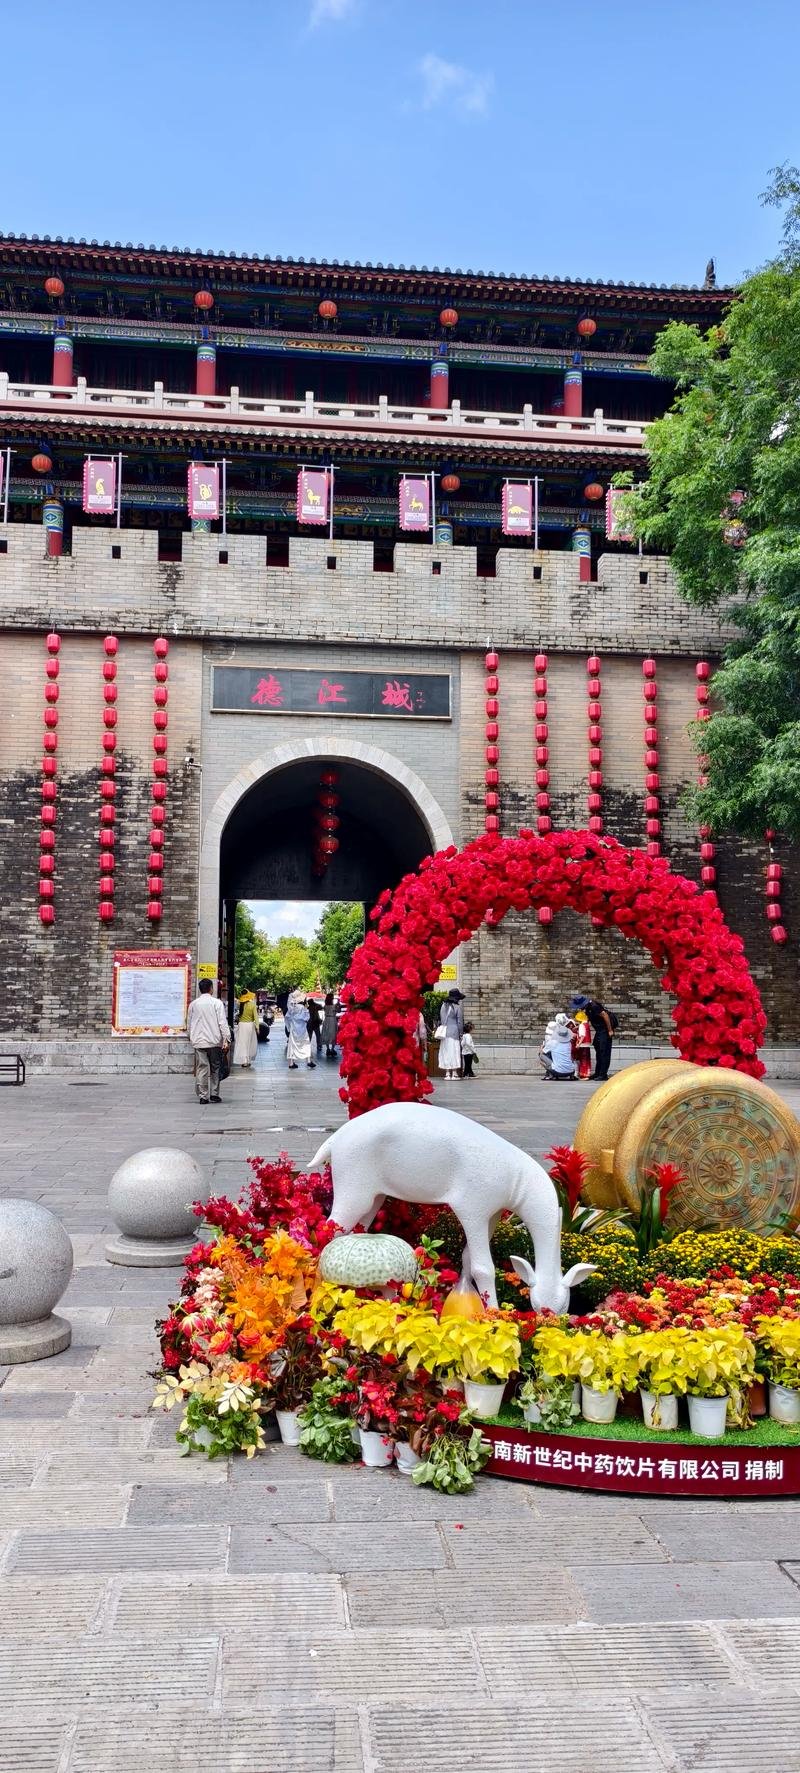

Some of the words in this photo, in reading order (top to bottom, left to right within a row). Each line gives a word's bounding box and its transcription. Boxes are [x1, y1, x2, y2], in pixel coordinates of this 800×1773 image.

[251, 673, 414, 712] 德江城
[745, 1459, 784, 1481] 捐制
